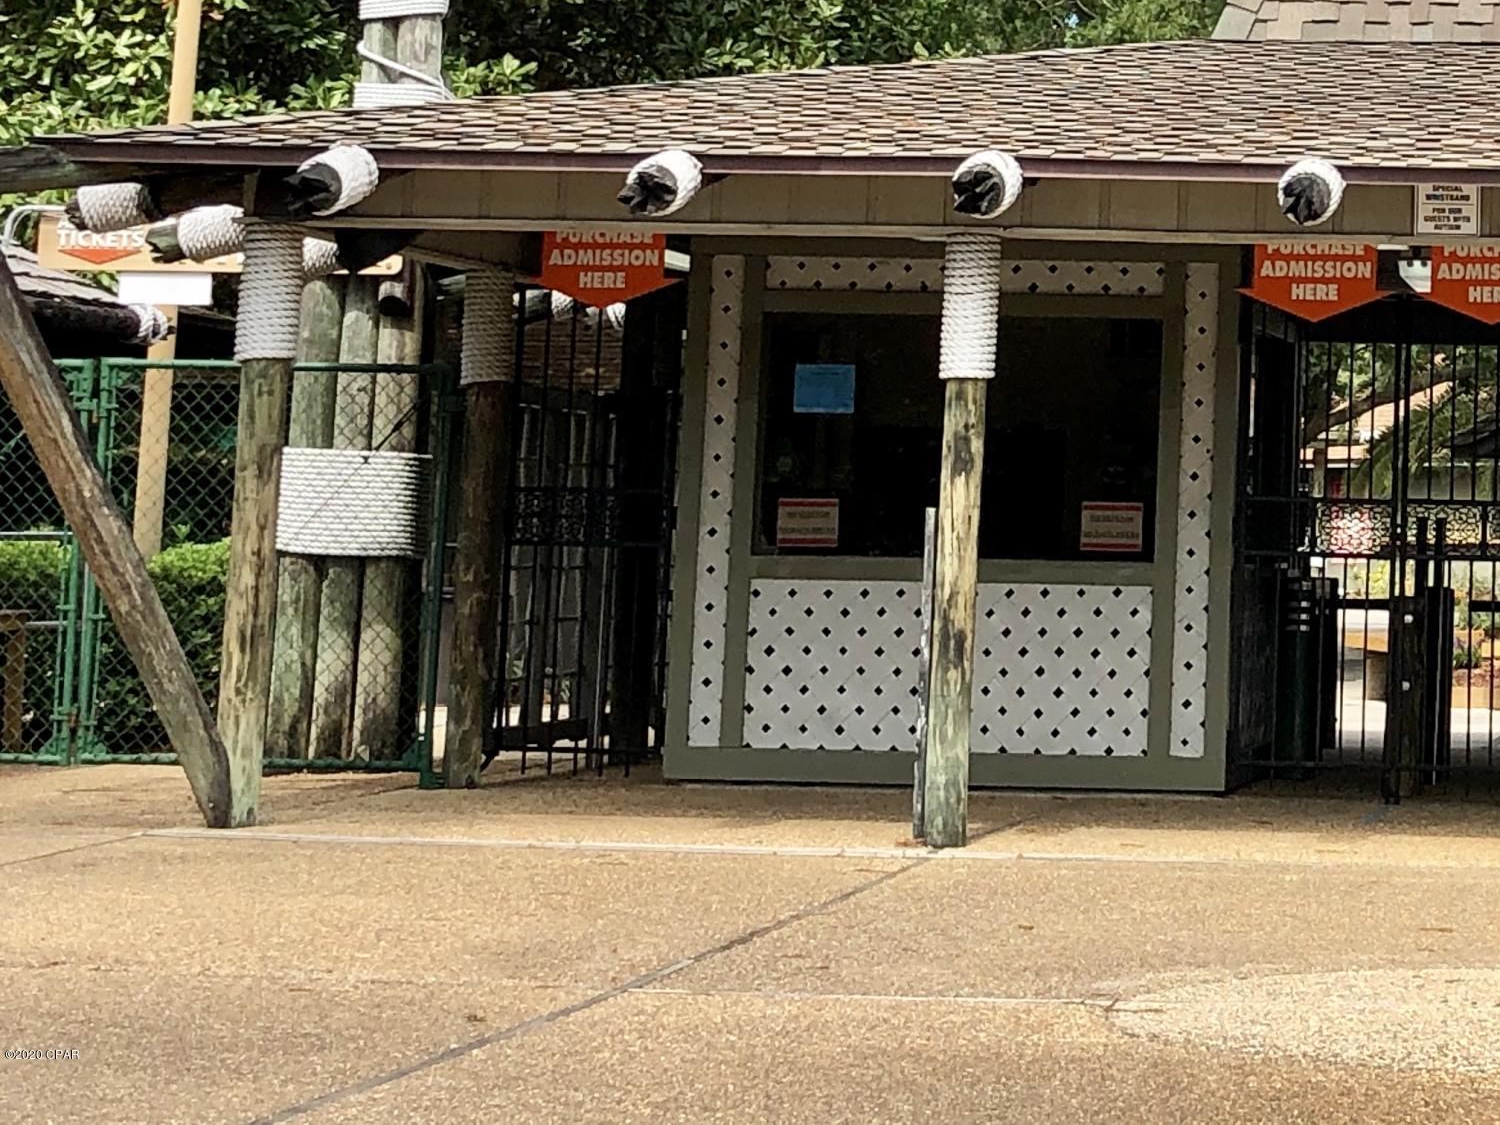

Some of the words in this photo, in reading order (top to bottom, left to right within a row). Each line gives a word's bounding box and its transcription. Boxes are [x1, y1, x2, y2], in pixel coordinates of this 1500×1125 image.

[57, 229, 145, 248] TICKETS
[556, 230, 653, 244] PURCHASE
[1267, 241, 1365, 255] PURCHASE
[549, 249, 659, 266] ADMISSION
[1260, 260, 1372, 278] ADMISSION
[579, 271, 626, 288] HERE
[1291, 282, 1338, 301] HERE
